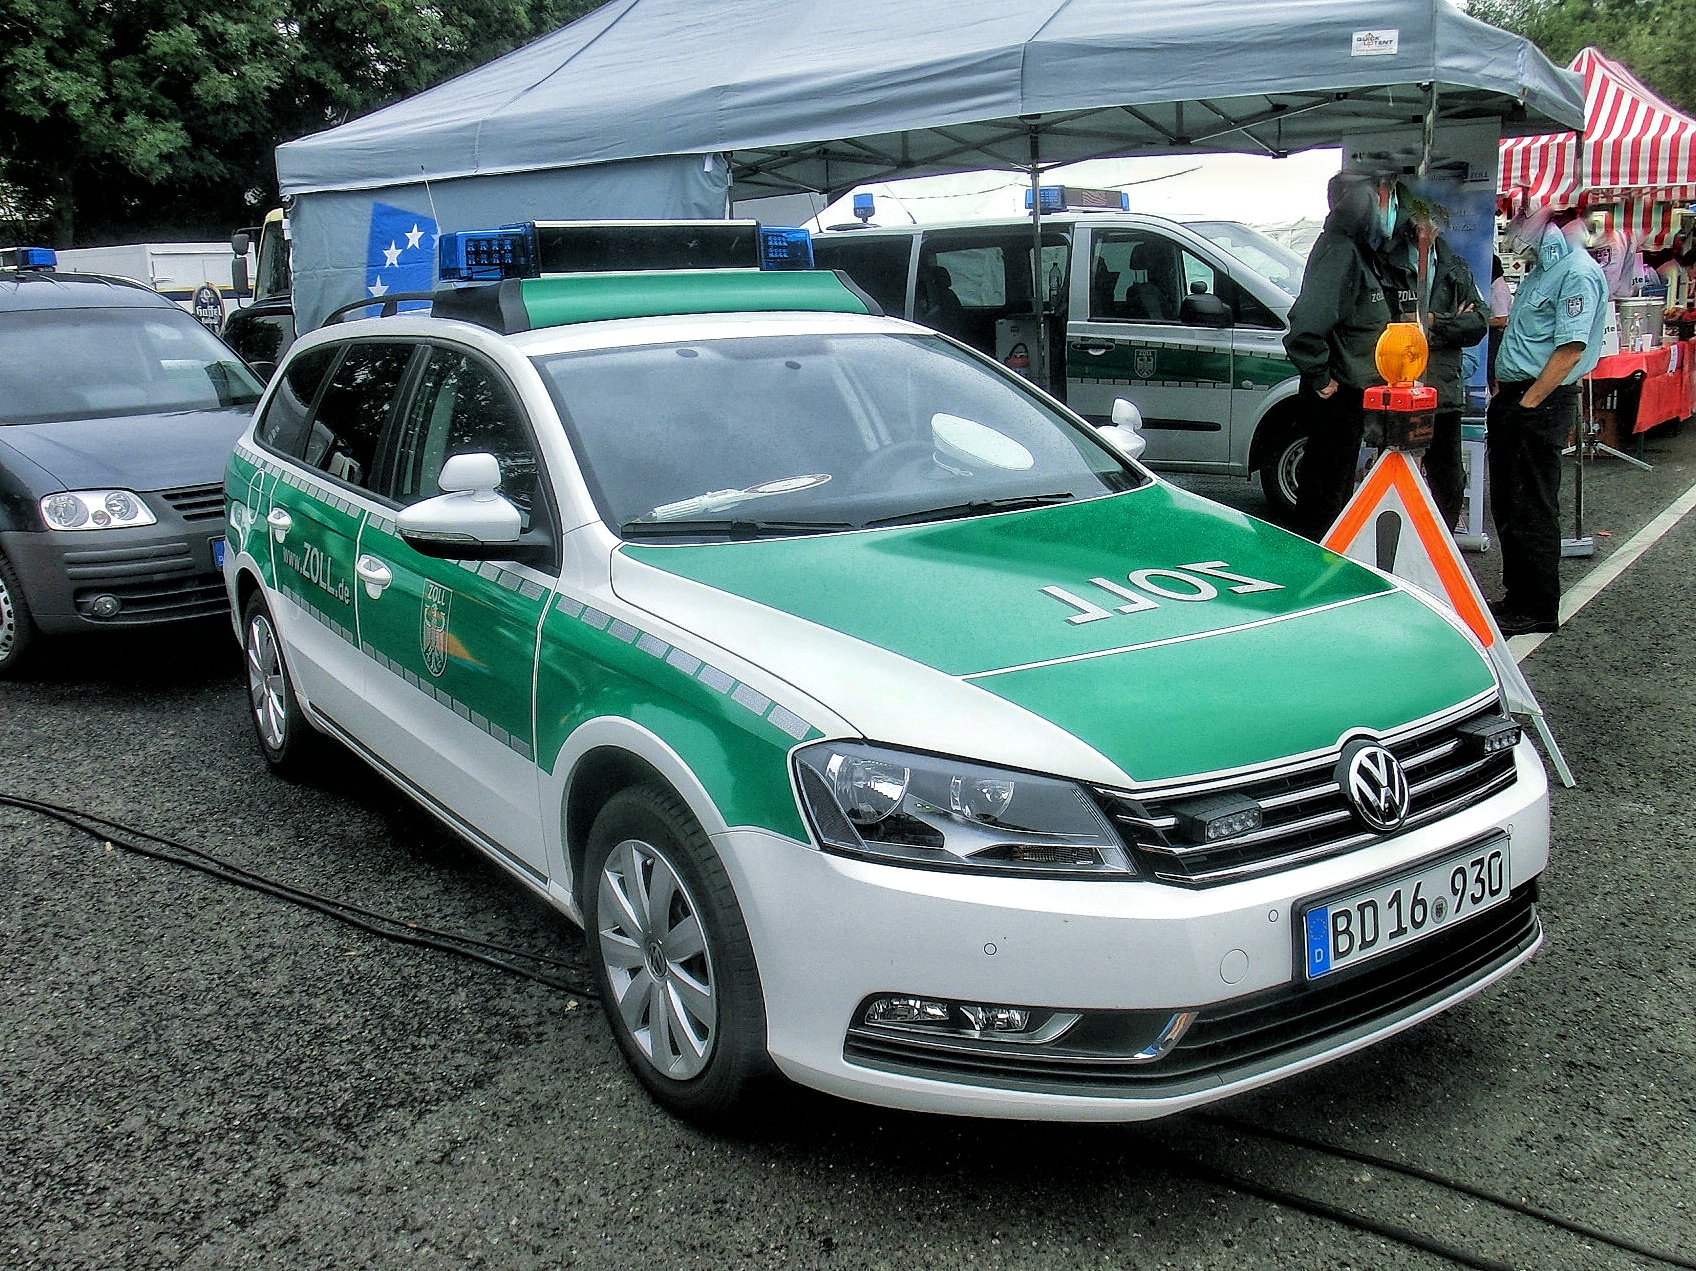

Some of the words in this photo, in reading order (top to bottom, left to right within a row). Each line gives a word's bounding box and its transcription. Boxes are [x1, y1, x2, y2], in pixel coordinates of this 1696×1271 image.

[1397, 289, 1418, 302] ZOLL
[282, 541, 349, 605] www.ZOLL.de
[428, 583, 445, 606] ZOLL
[1450, 850, 1503, 914] 930
[1314, 948, 1325, 964] D
